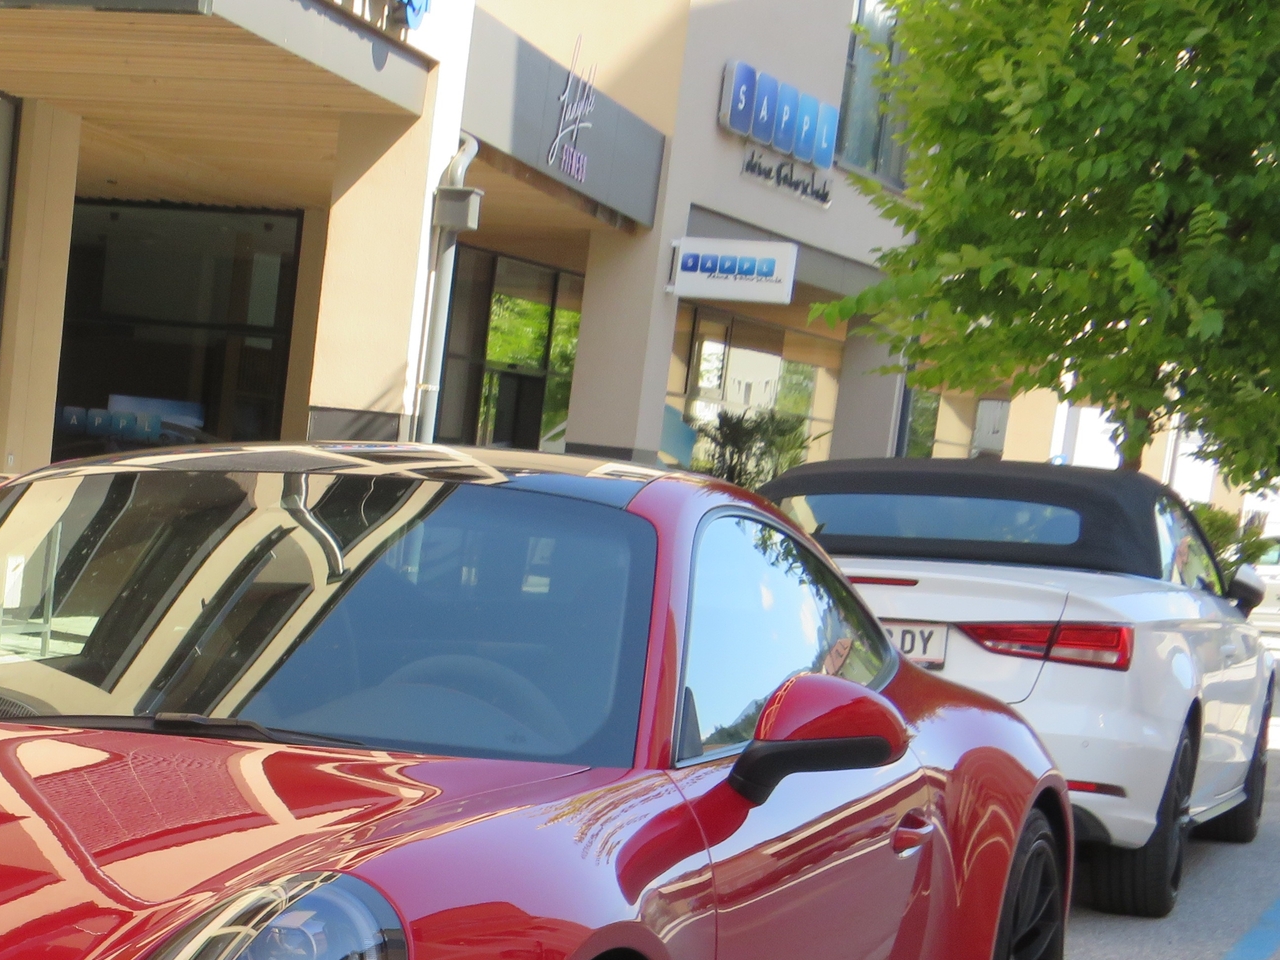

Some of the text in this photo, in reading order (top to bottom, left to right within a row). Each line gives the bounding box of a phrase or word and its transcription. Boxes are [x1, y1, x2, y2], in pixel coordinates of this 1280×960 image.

[738, 84, 828, 149] SAPPL
[560, 143, 588, 183] FITNESS
[687, 257, 768, 272] SAPPL
[69, 414, 151, 432] APPL
[886, 629, 933, 655] DY
